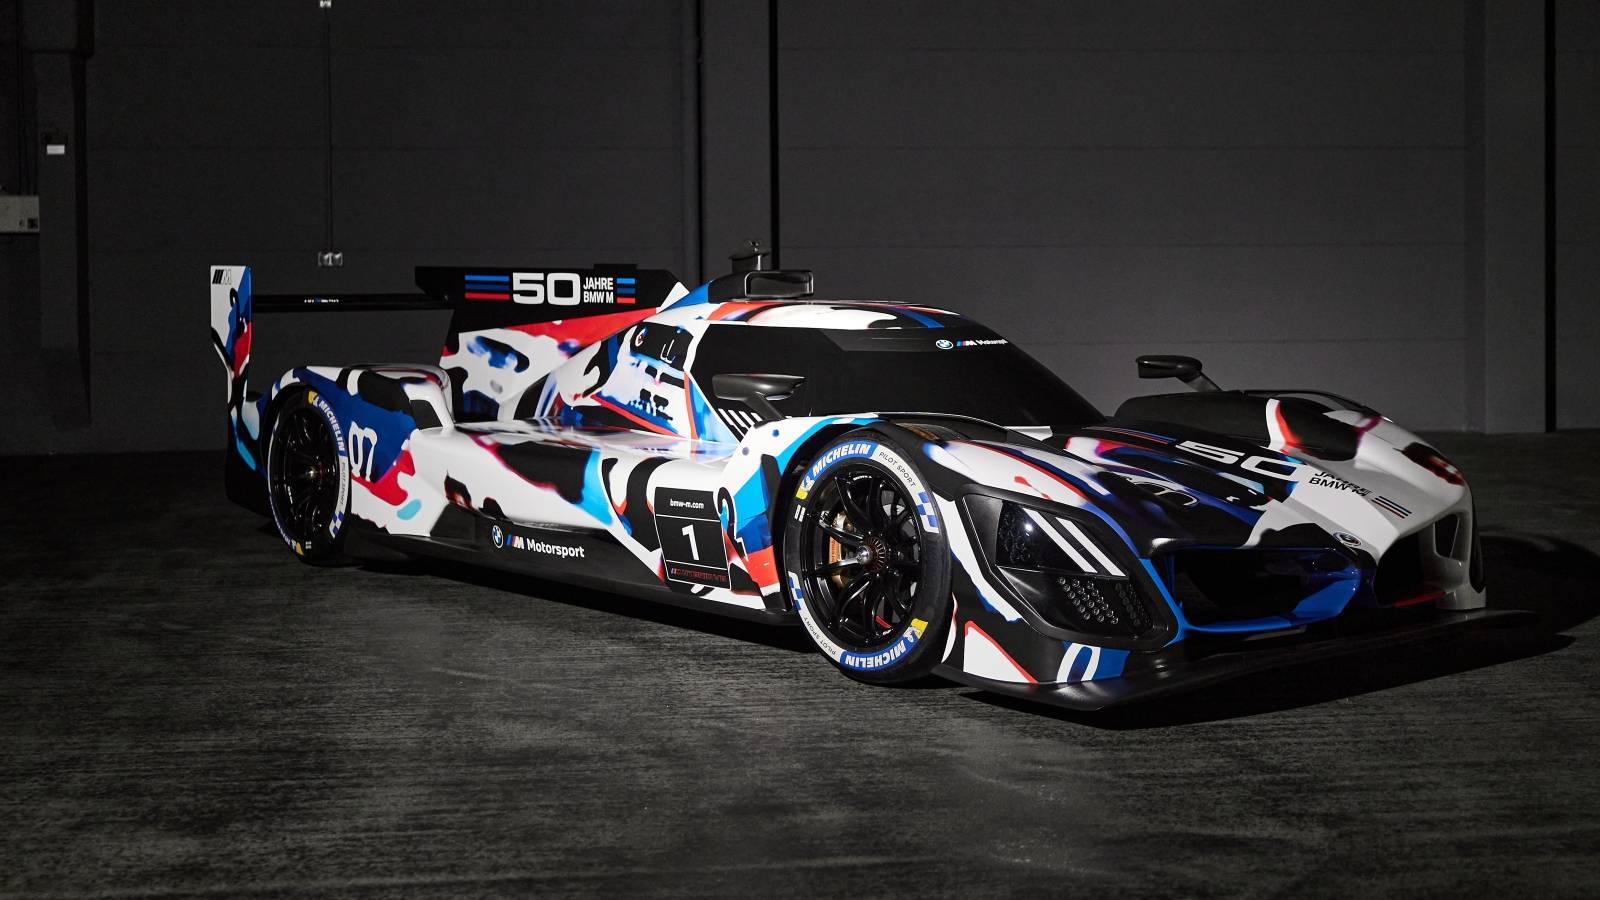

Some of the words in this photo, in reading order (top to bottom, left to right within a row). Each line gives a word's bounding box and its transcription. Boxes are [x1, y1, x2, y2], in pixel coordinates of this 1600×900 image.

[512, 272, 581, 306] 50
[583, 277, 614, 290] JAHRE
[583, 291, 604, 303] BMW
[605, 292, 614, 304] M
[318, 399, 346, 451] MICHELIN
[812, 443, 872, 477] MICHELIN
[879, 451, 898, 467] PILOT
[897, 465, 917, 488] SPORT
[1175, 440, 1306, 482] 50
[1309, 477, 1351, 491] BMW
[669, 498, 705, 510] bmw-m.com
[526, 537, 585, 559] Motorsport
[681, 524, 700, 561] 1
[803, 616, 821, 641] SPORT
[819, 639, 837, 656] PILOT
[845, 639, 907, 668] MICHELIN
